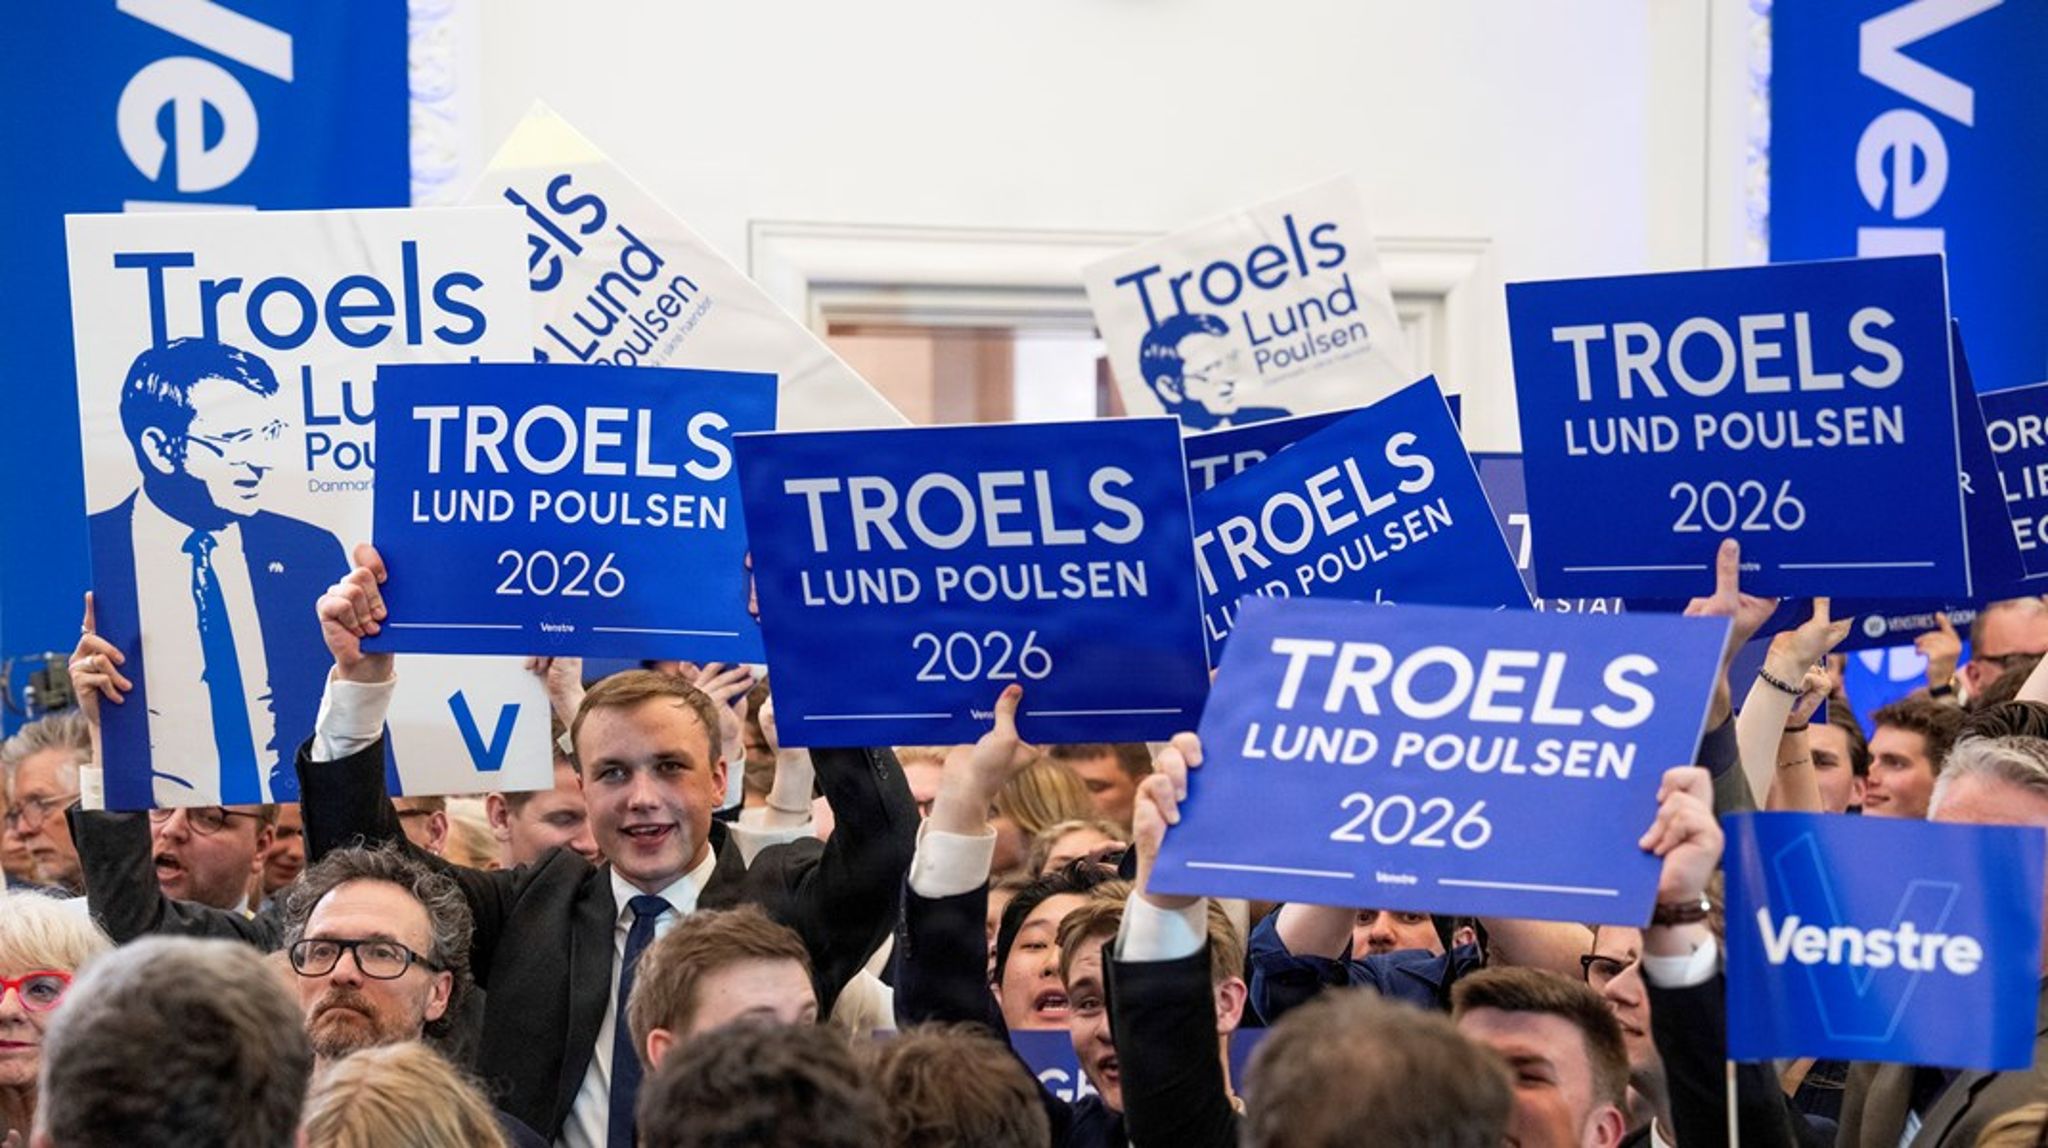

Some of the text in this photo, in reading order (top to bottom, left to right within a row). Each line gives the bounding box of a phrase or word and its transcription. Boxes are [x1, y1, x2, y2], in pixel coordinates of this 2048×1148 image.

[116, 0, 293, 213] Ve
[114, 240, 487, 351] Troels
[543, 224, 665, 362] Lund
[1115, 213, 1346, 329] Troels
[594, 275, 699, 367] oulsen
[1242, 272, 1358, 347] Lund
[1254, 322, 1368, 373] Poulsen
[1552, 307, 1903, 401] TROELS
[413, 405, 732, 481] TROELS
[1565, 406, 1905, 456] LUND POULSEN
[1987, 415, 2048, 453] OR
[309, 478, 374, 493] Danmar
[412, 490, 727, 530] LUND POULSEN
[784, 466, 1144, 552] TROELS
[1194, 431, 1435, 596] TROELS
[1669, 480, 1806, 533] 2026
[496, 550, 625, 598] 2026
[801, 560, 1148, 606] LUND POULSEN
[1296, 497, 1453, 596] POULSEN
[912, 630, 1053, 682] 2026
[1271, 637, 1660, 730] TROELS
[447, 689, 521, 772] V
[1241, 723, 1636, 780] LUND POULSEN
[1330, 792, 1492, 850] 2026
[1756, 906, 1983, 975] Venstre
